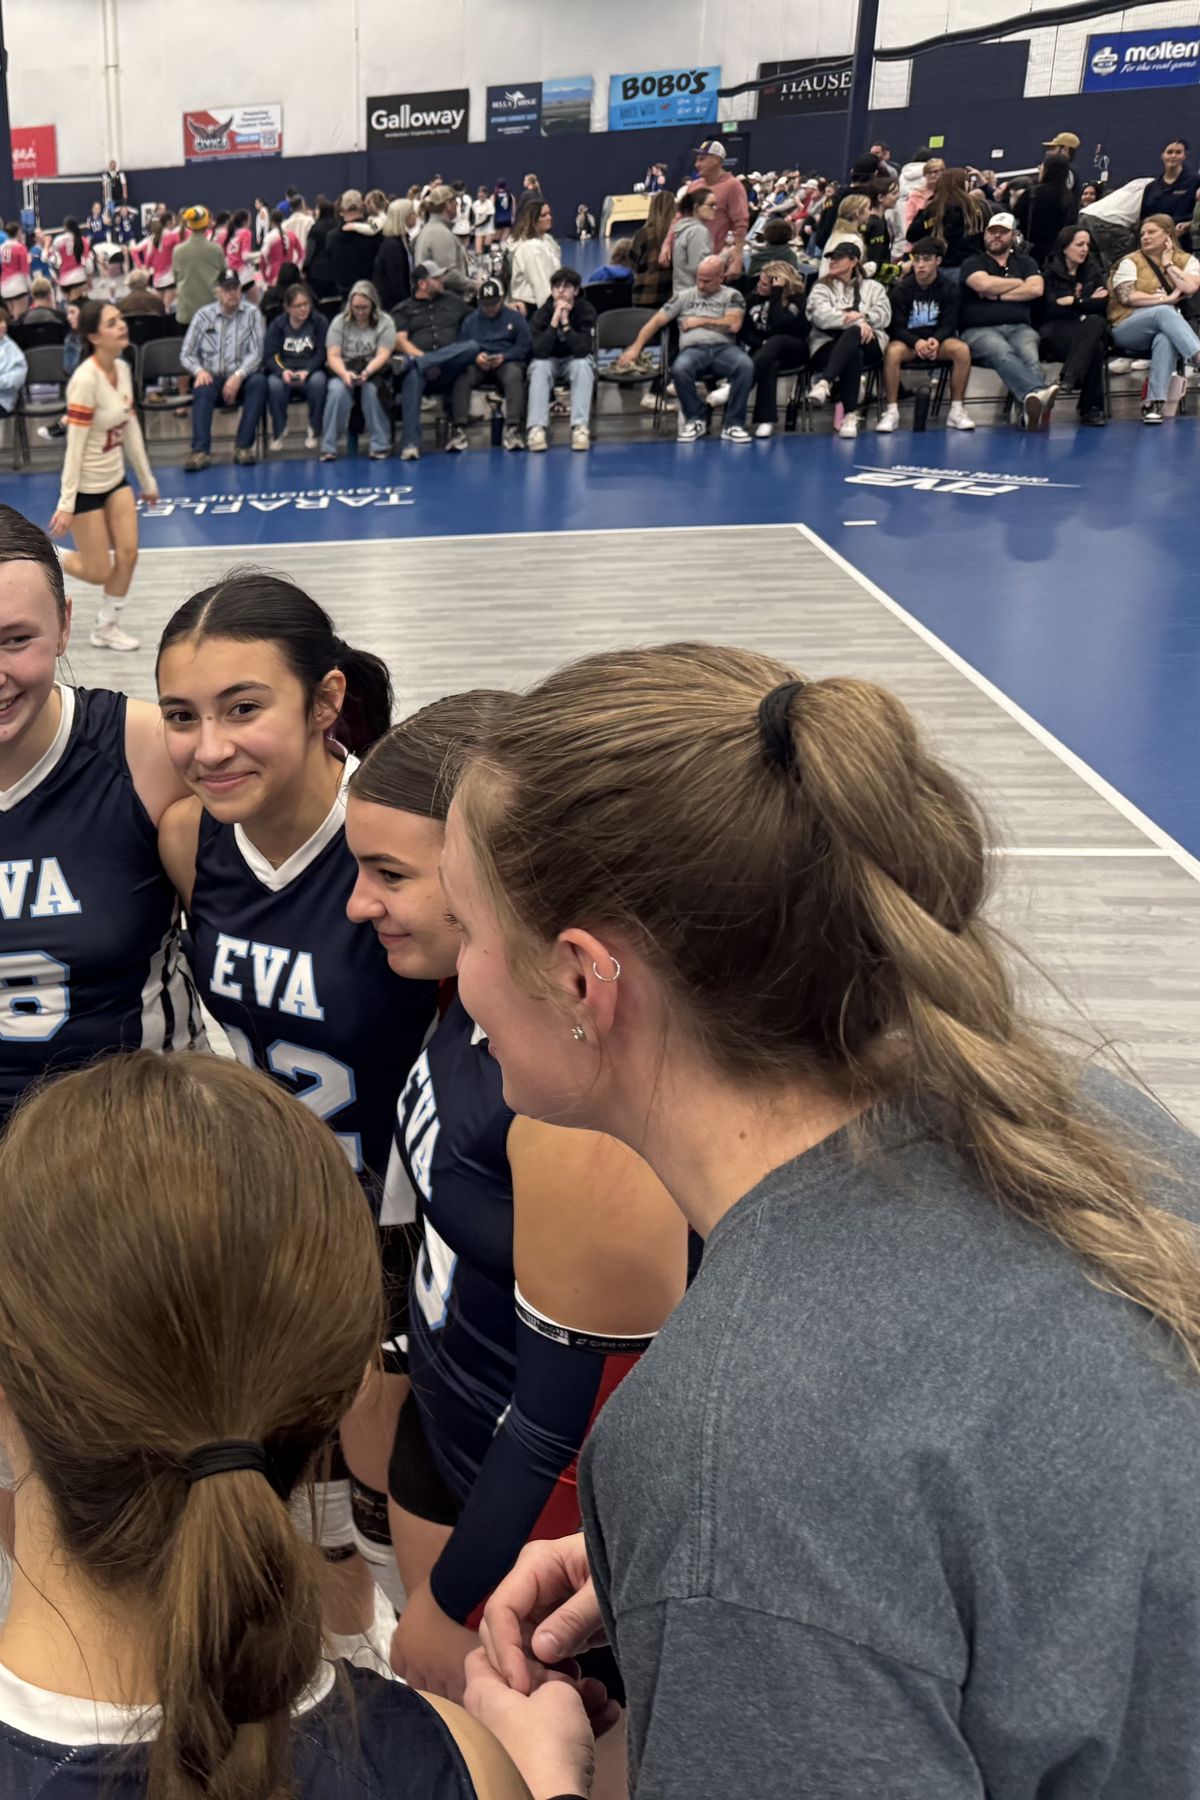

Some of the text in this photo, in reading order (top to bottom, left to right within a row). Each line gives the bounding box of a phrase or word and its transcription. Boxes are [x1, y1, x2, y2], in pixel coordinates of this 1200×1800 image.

[1125, 41, 1199, 62] molten
[622, 69, 709, 100] BOBO'S
[371, 104, 465, 130] Galloway
[483, 286, 494, 297] N
[136, 492, 415, 517] TARAFLE
[210, 932, 324, 1021] EVA
[397, 1048, 440, 1203] EVA
